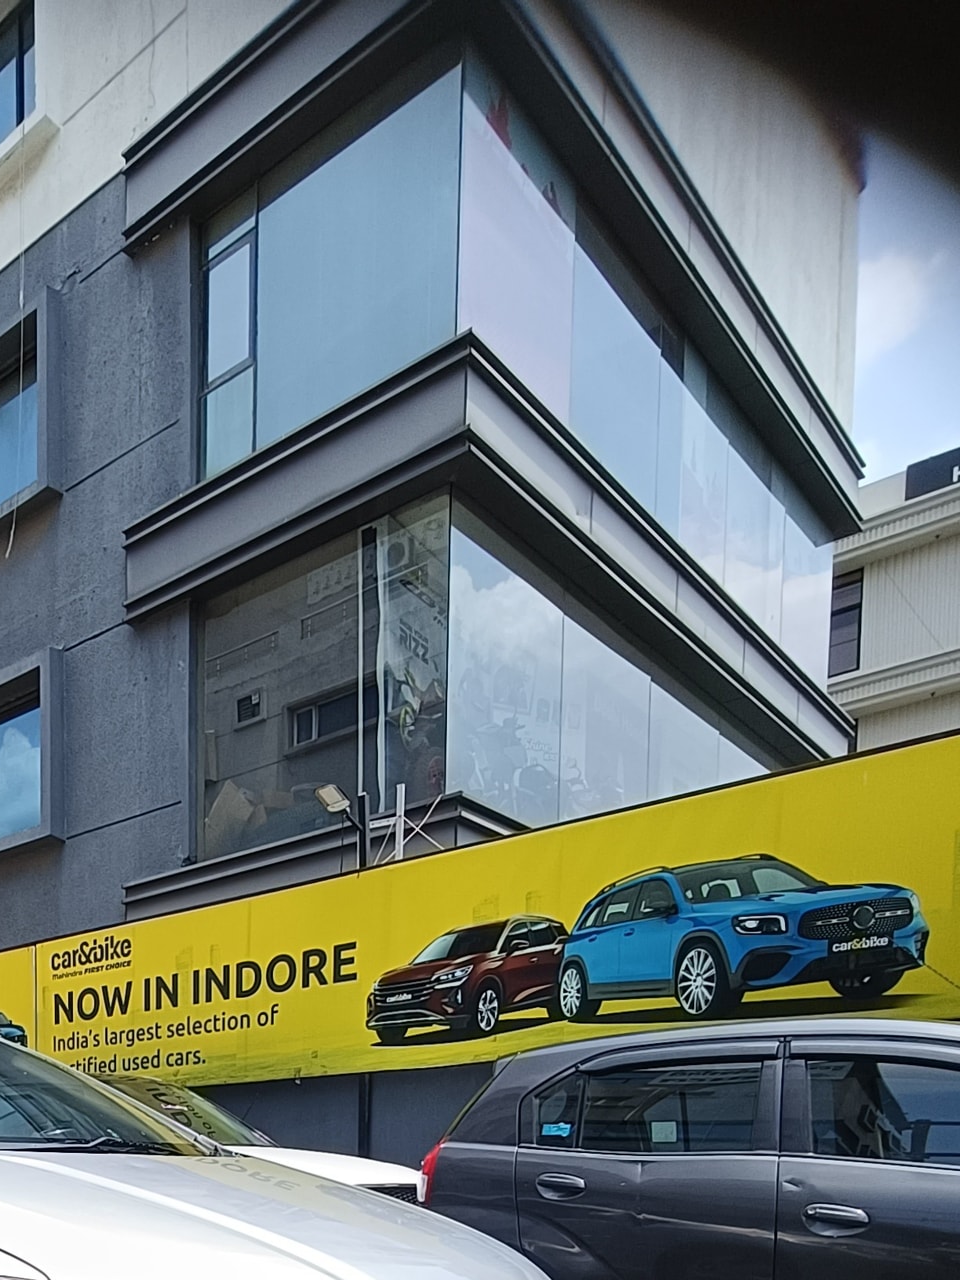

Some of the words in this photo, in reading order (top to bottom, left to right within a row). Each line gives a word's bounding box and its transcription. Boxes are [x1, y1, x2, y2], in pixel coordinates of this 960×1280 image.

[51, 935, 132, 971] car&bike
[832, 936, 889, 952] car&bike
[84, 964, 105, 976] FIRST
[105, 959, 132, 971] CHOICE
[54, 981, 133, 1025] NOW
[143, 973, 179, 1012] IN
[192, 941, 358, 1005] INDORE
[104, 1022, 162, 1049] largest
[166, 1012, 251, 1039] selection
[257, 1003, 280, 1028] of
[122, 1048, 161, 1071] used
[166, 1049, 207, 1068] cars.
